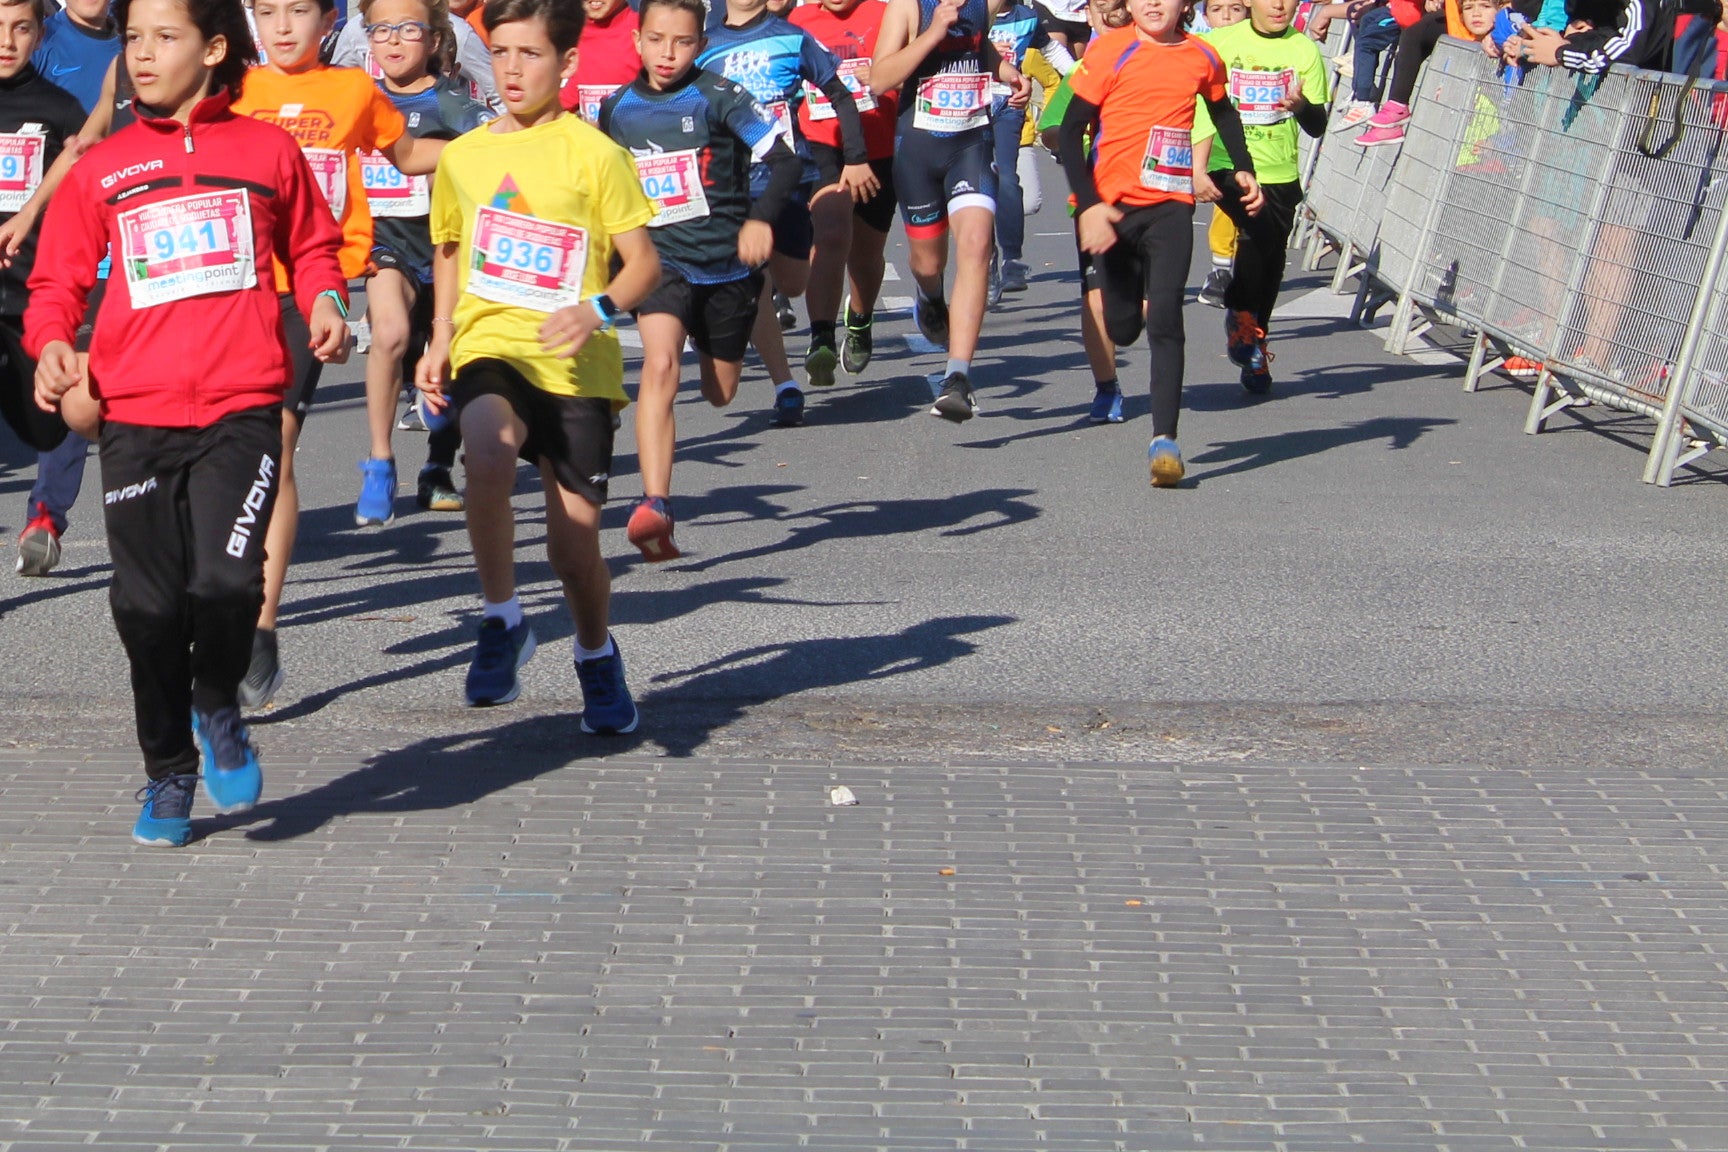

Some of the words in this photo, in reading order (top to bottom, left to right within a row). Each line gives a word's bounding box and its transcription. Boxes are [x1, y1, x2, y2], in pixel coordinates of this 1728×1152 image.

[938, 90, 975, 108] 933
[1245, 87, 1282, 103] 926
[100, 159, 164, 189] GIVOVA
[364, 166, 401, 187] 949
[644, 174, 677, 198] 04
[187, 198, 222, 213] POPULAR
[153, 221, 216, 259] 941
[496, 237, 553, 273] 936
[148, 266, 240, 292] meetingpoint
[105, 476, 159, 505] GIVOVA
[225, 453, 275, 558] GIVOVA
